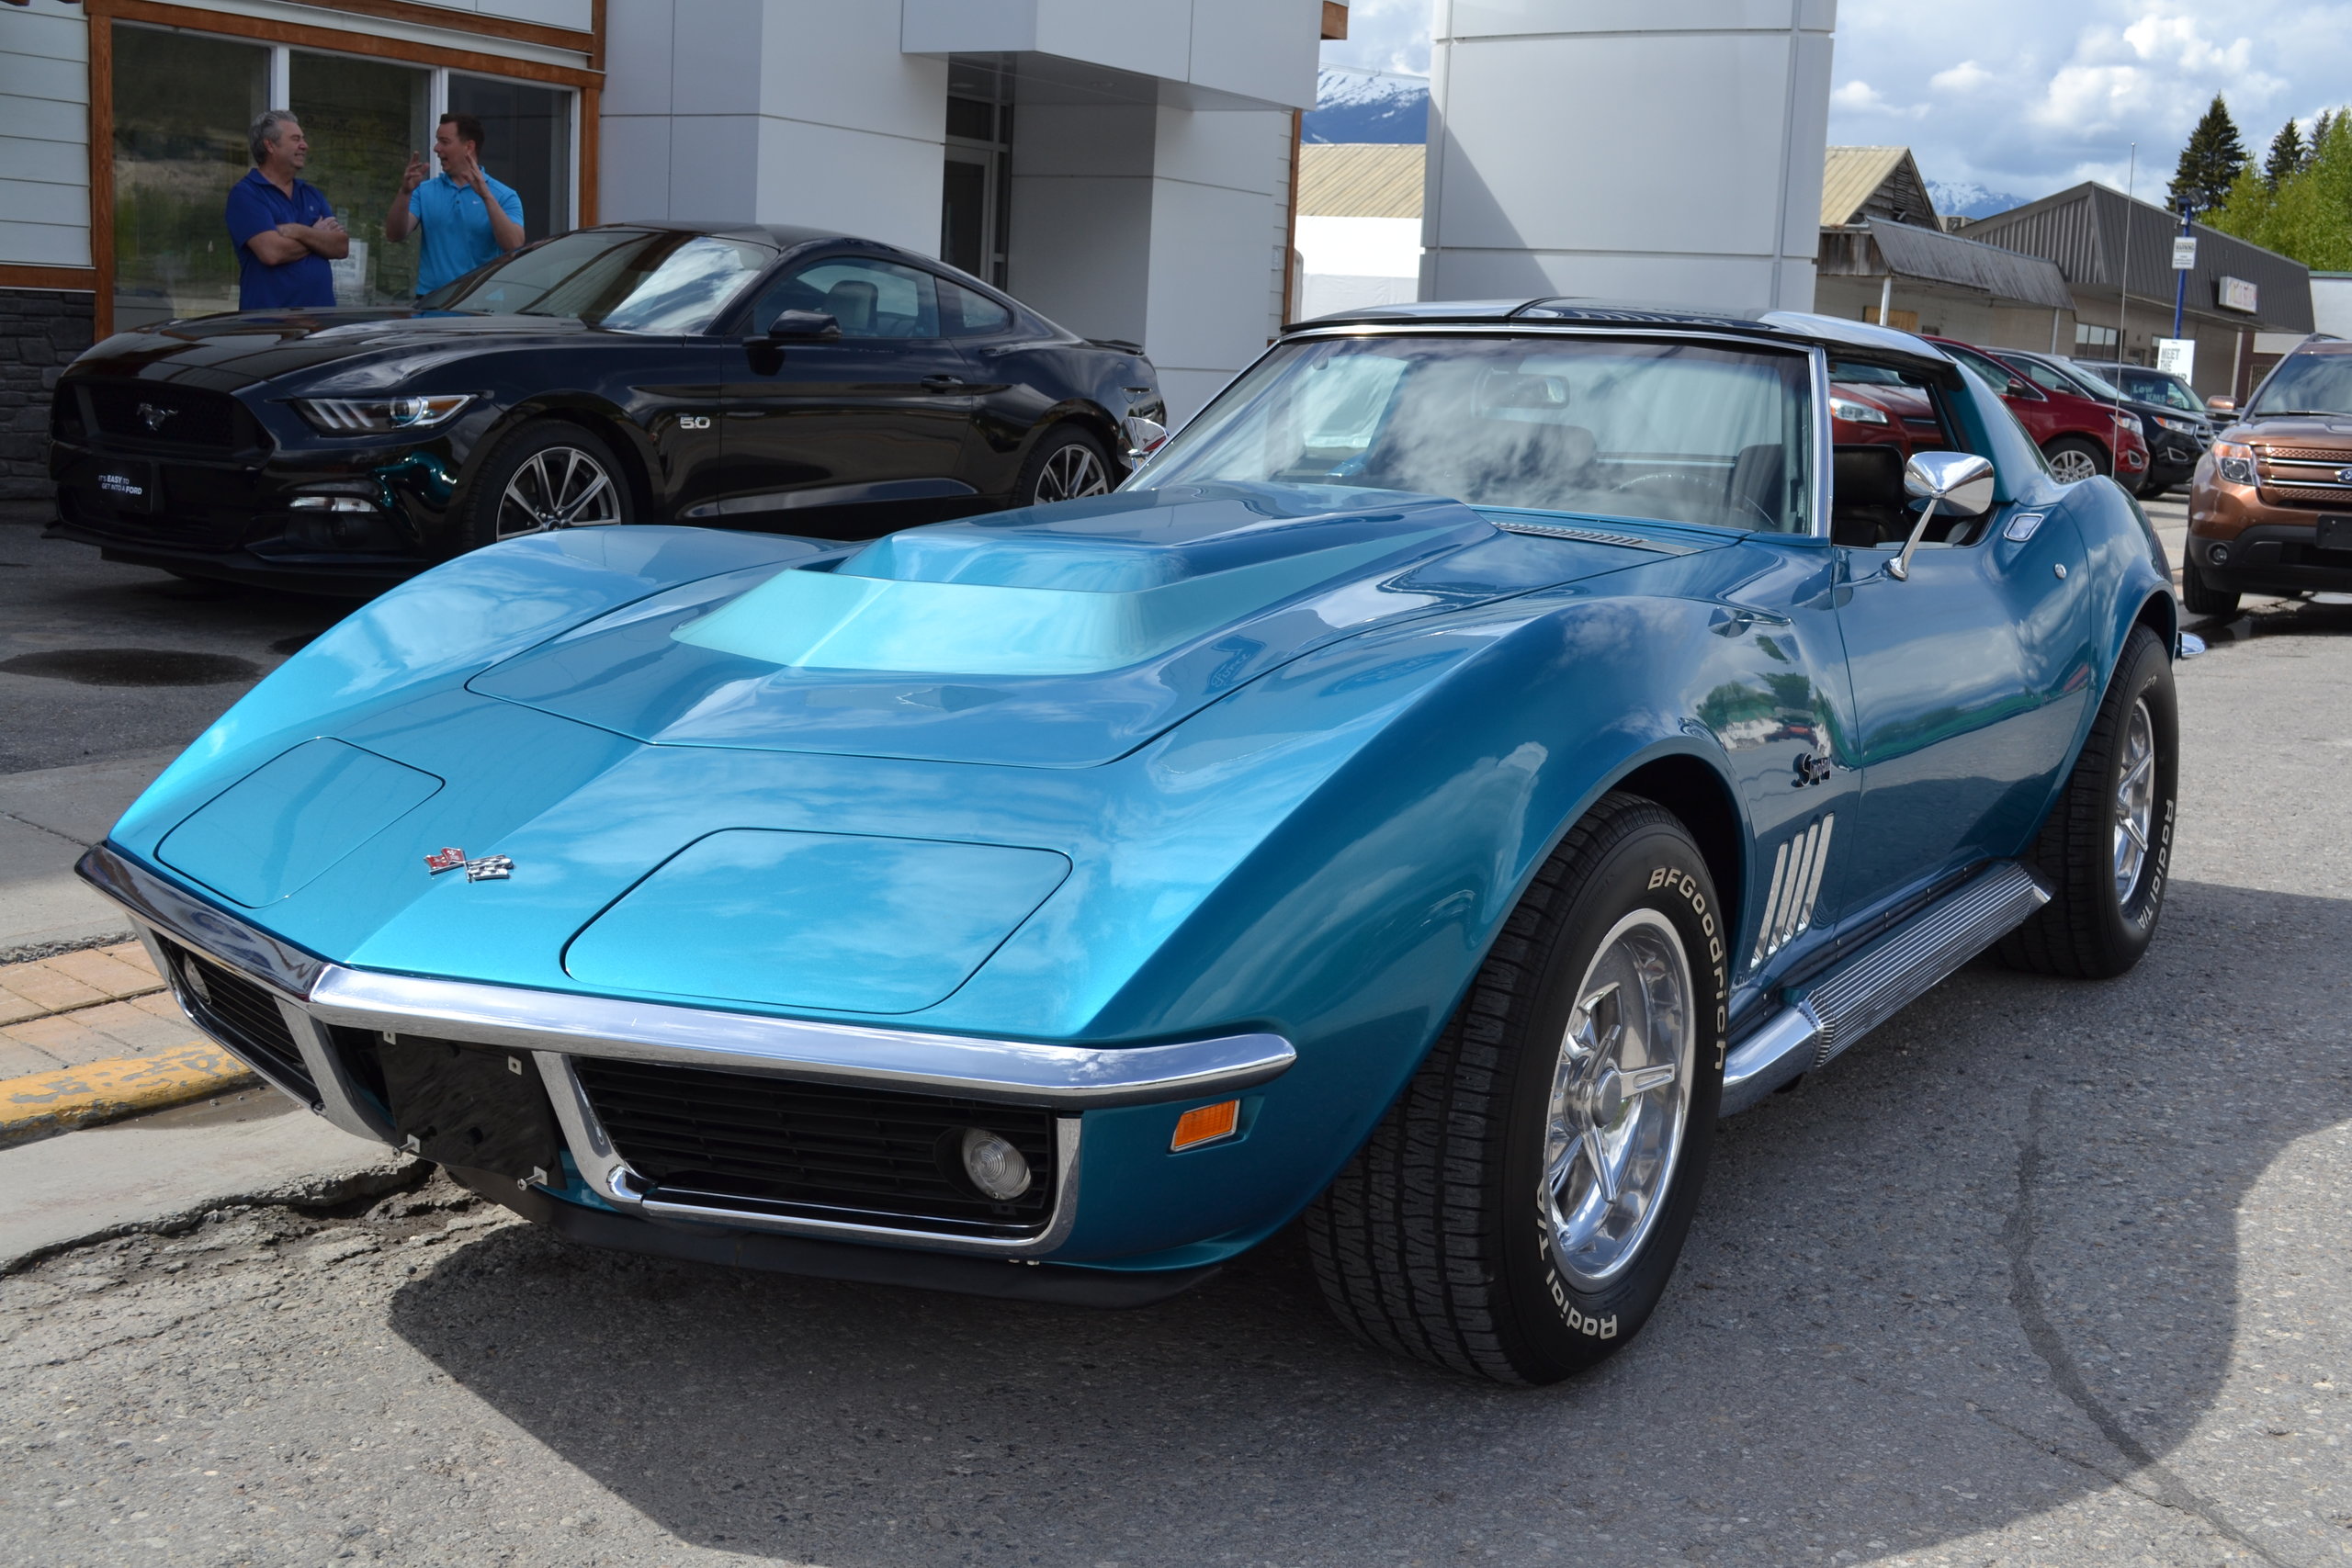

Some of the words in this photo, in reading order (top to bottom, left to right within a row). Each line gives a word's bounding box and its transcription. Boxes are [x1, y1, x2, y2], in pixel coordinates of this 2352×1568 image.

[107, 475, 122, 483] EASY
[126, 486, 142, 494] FORD
[2150, 799, 2174, 903] Radial
[2137, 905, 2154, 930] T/A
[1647, 867, 1727, 1070] BFGoodrich
[1545, 1268, 1618, 1340] Radial
